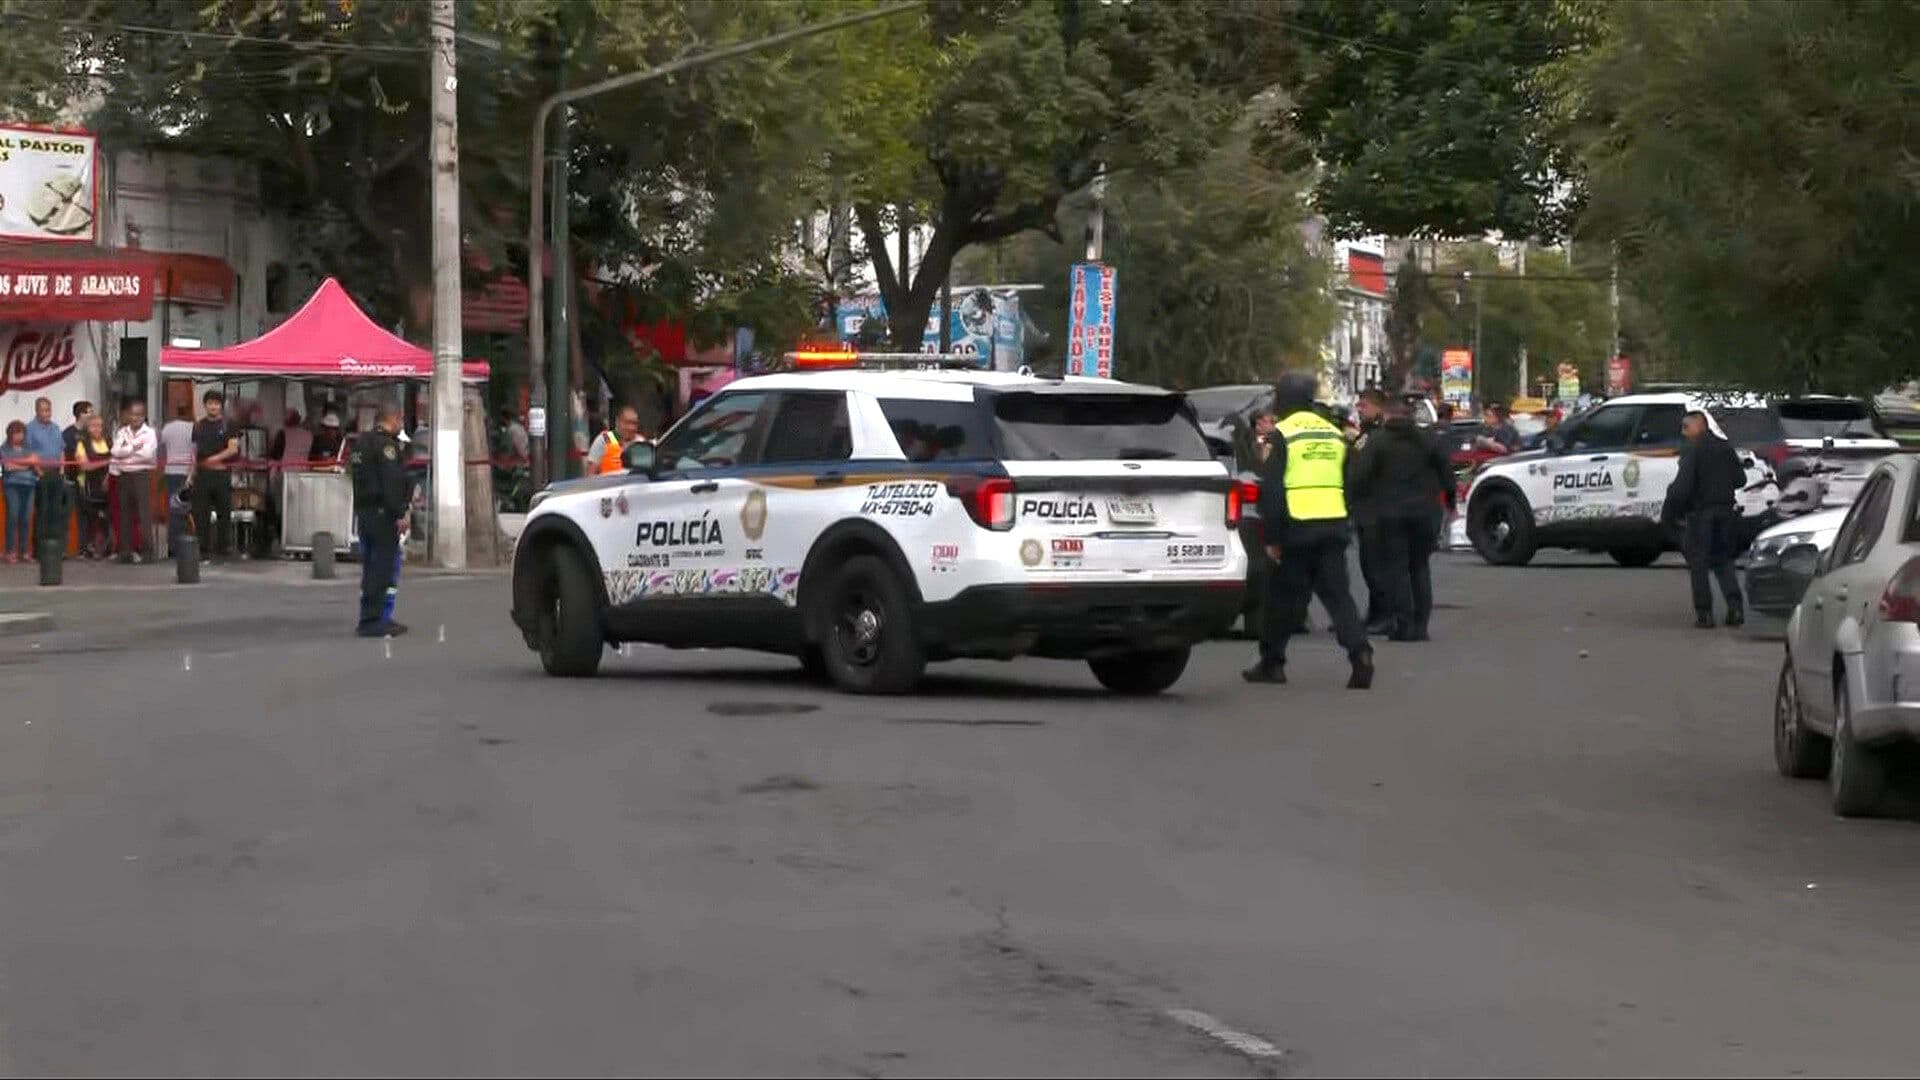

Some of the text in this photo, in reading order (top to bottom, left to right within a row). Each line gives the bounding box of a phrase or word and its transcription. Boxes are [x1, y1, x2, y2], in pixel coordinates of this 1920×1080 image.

[20, 139, 85, 154] PASTOR
[14, 275, 48, 296] JUVE
[55, 275, 72, 296] DE
[80, 275, 139, 296] ARANDAS
[1553, 465, 1613, 489] POLICÍA
[1022, 494, 1097, 518] POLICÍA
[636, 509, 723, 546] POLICÍA
